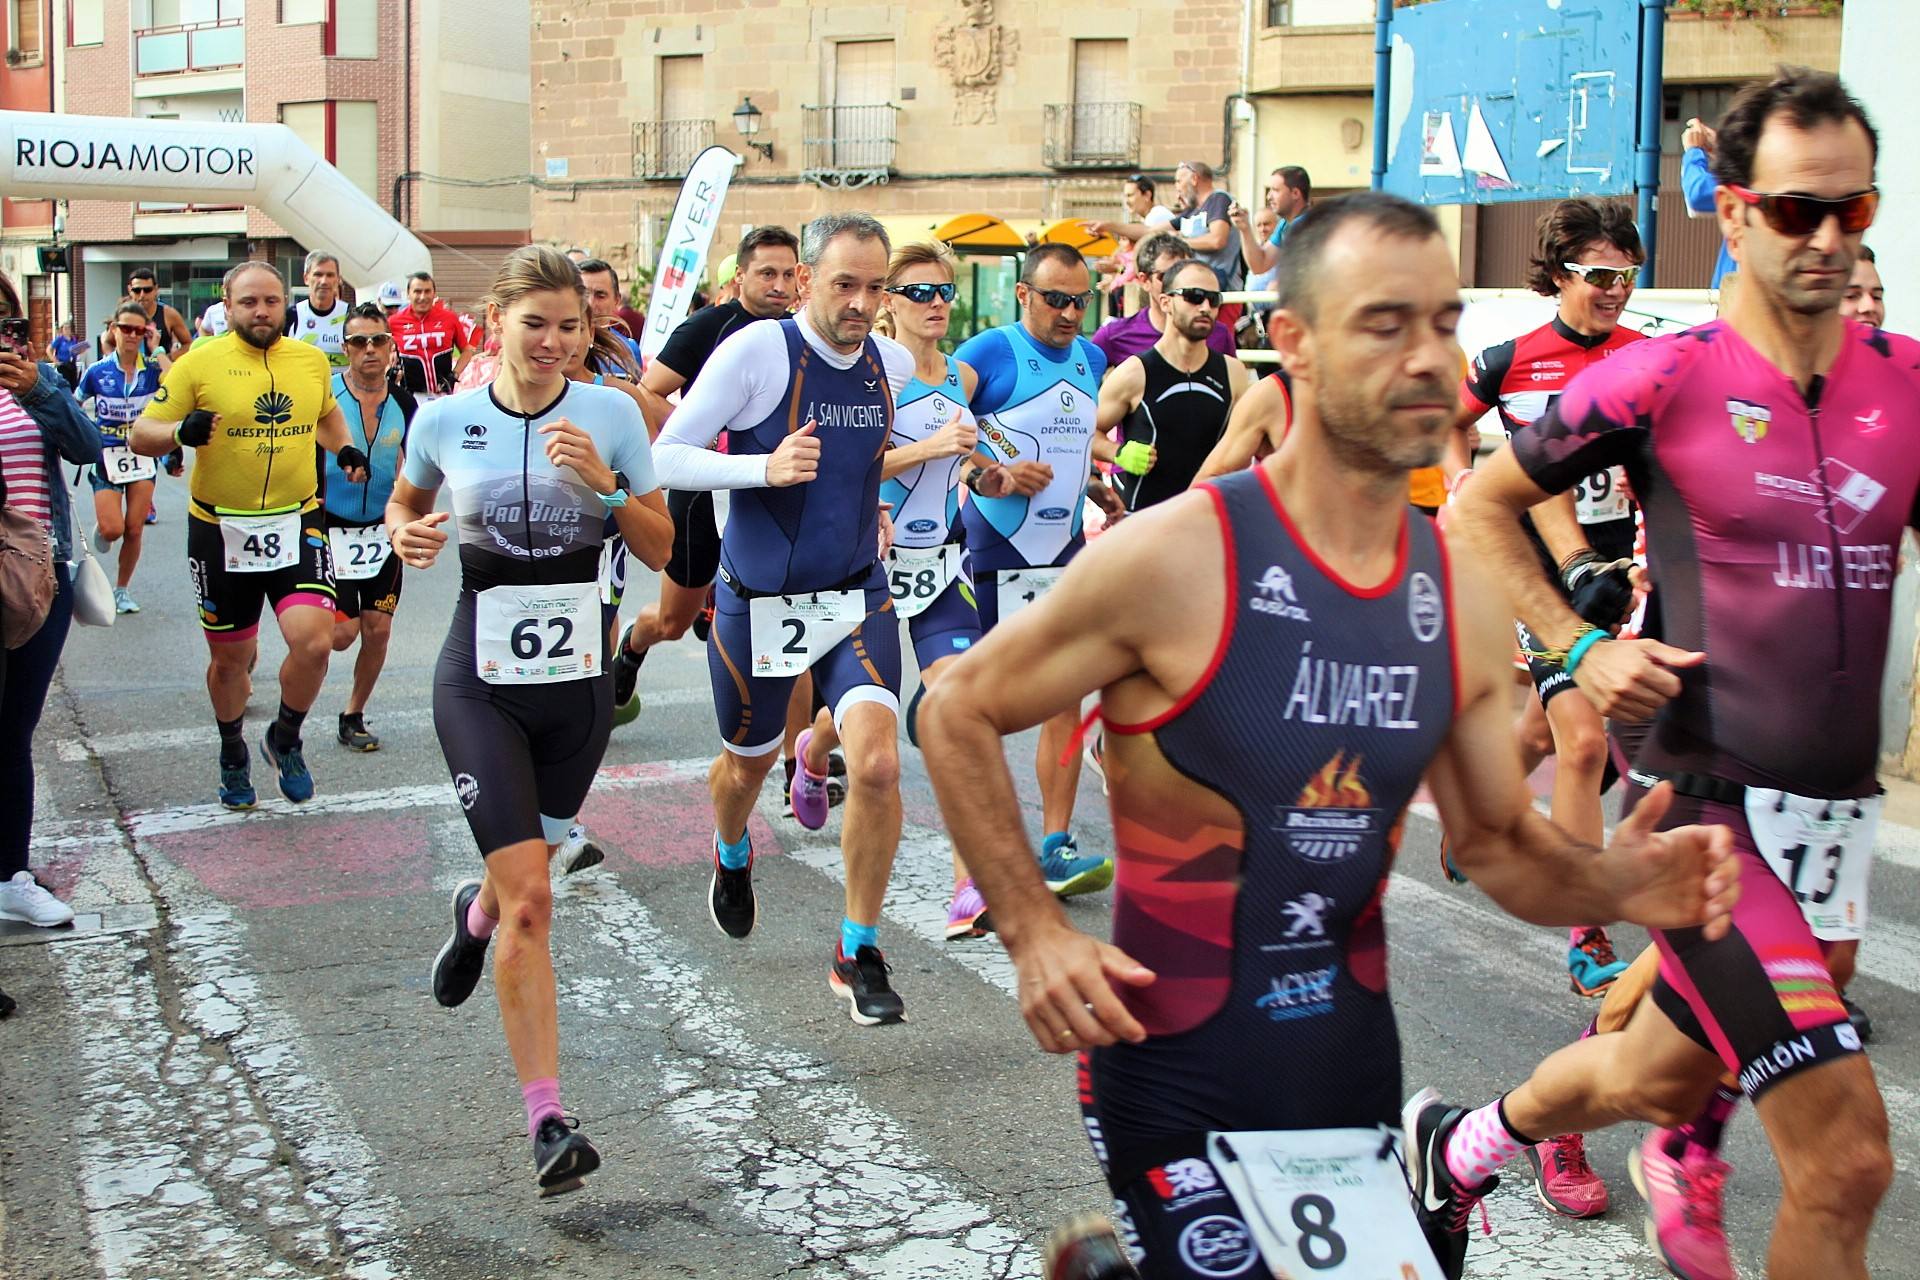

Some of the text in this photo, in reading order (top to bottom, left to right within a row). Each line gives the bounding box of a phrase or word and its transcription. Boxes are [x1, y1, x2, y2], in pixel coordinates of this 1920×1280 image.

[16, 138, 254, 175] RIOJAMOTOR
[655, 180, 713, 335] CLOVER
[402, 331, 446, 350] ZTT
[818, 402, 840, 427] SAN
[841, 405, 885, 427] VICENTE
[1053, 416, 1081, 425] SALUD
[1041, 426, 1088, 435] DEPORTIVA
[117, 457, 142, 473] 61
[243, 532, 281, 559] 48
[349, 542, 383, 566] 22
[890, 569, 936, 600] 58
[511, 616, 574, 660] 62
[782, 618, 808, 654] 2
[1283, 640, 1420, 729] ÁLVAREZ
[1782, 843, 1843, 905] 13
[1291, 1193, 1347, 1271] 8
